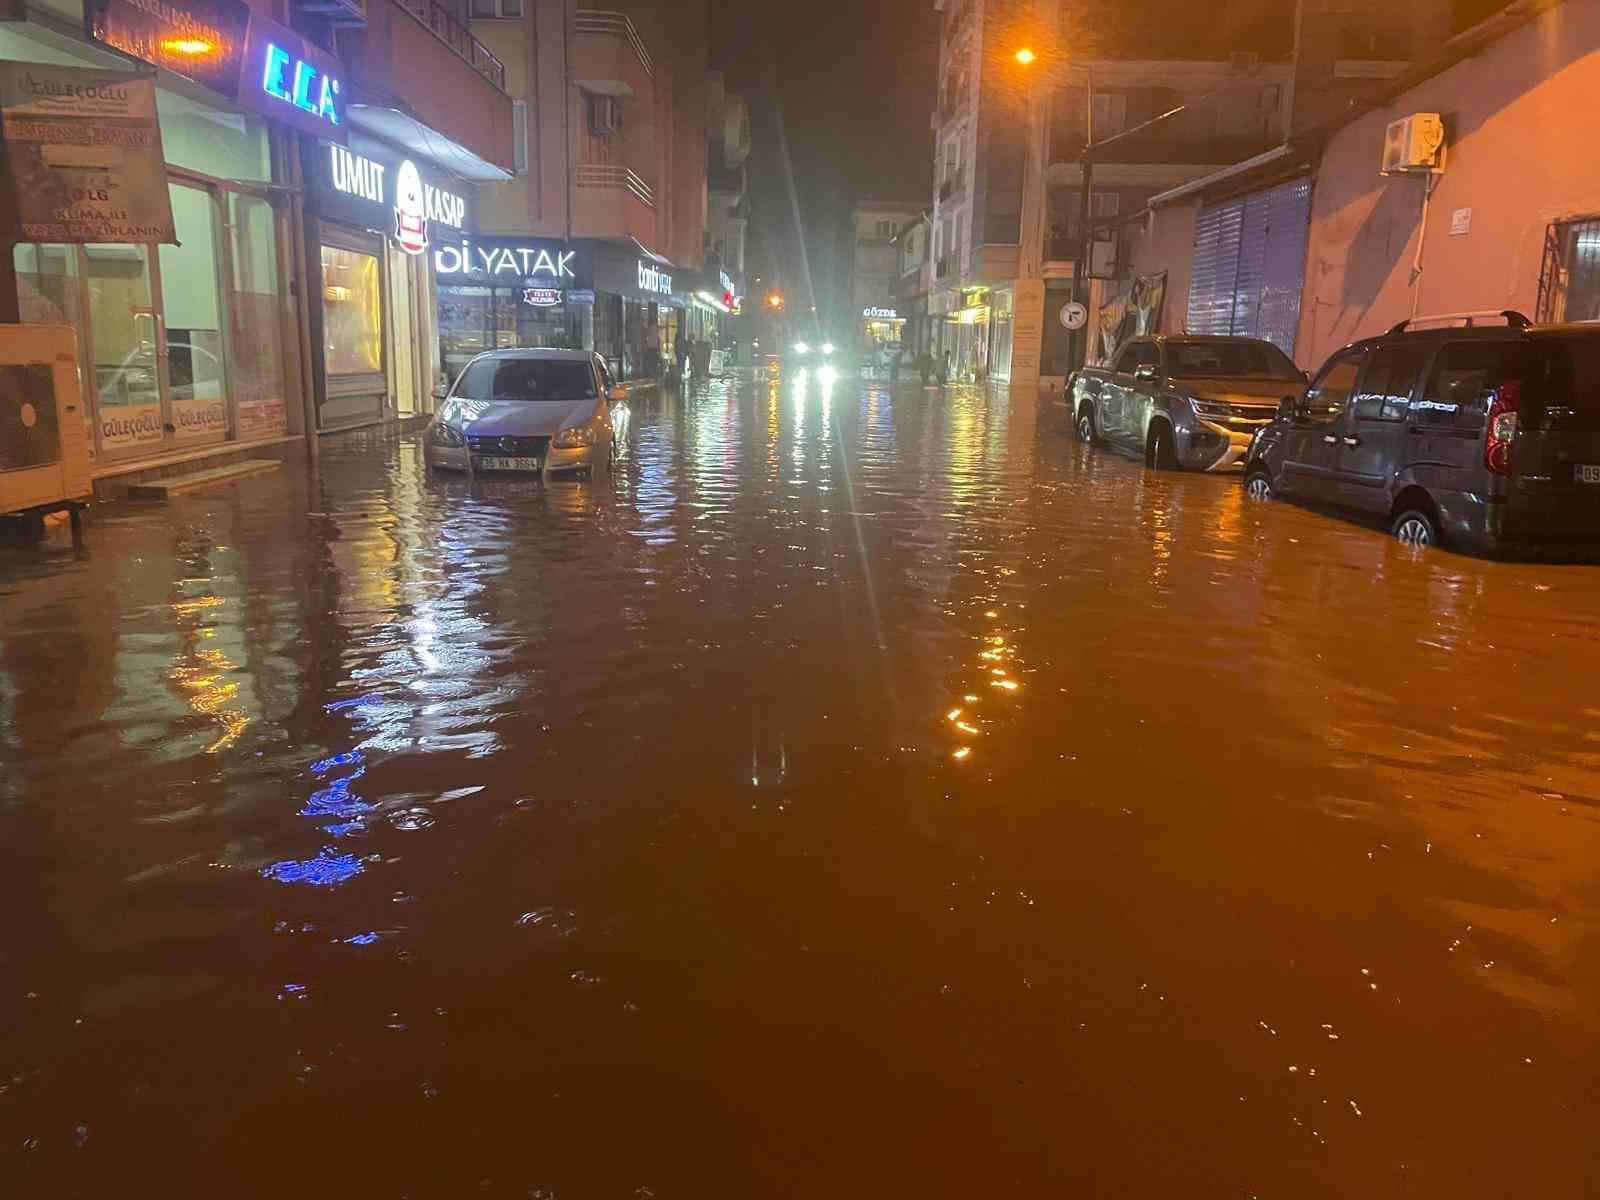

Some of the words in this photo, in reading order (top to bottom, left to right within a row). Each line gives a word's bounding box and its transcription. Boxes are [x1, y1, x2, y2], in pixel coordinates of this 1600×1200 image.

[331, 144, 384, 203] UMUT
[88, 188, 110, 201] LG
[424, 183, 464, 229] KASAP
[477, 246, 577, 278] YATAK
